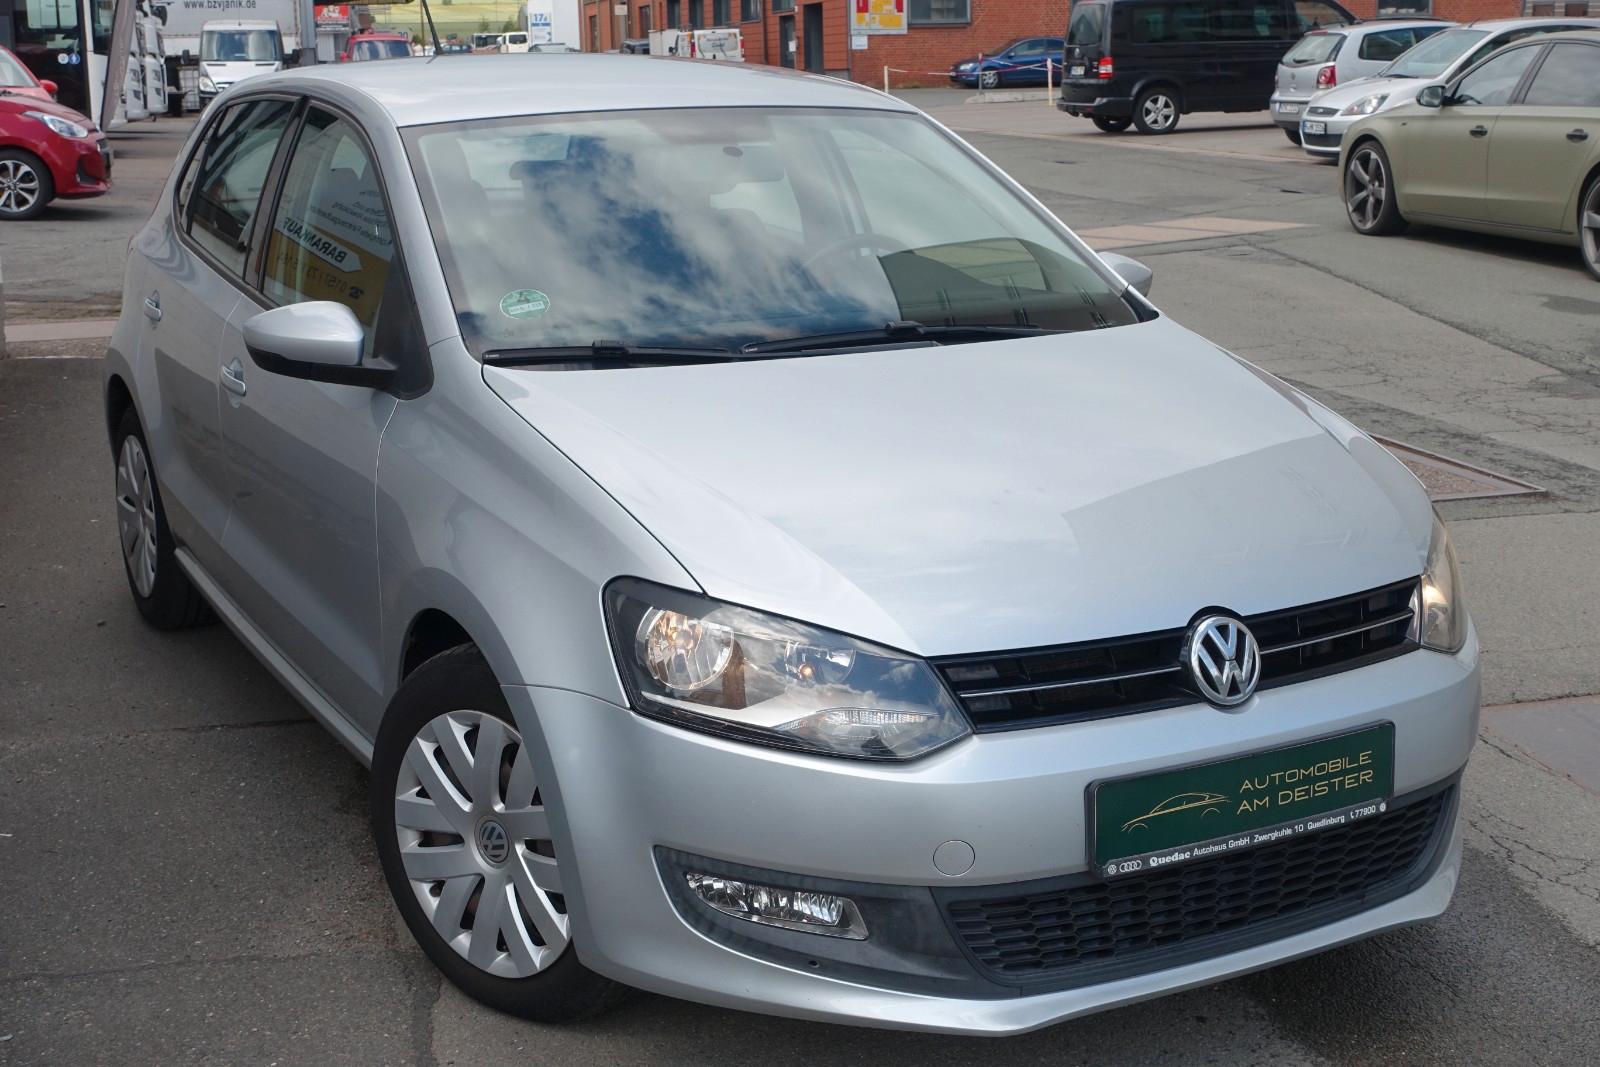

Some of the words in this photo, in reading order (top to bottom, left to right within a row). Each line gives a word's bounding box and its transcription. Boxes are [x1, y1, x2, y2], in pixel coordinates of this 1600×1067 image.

[1236, 796, 1269, 815] AM
[1278, 769, 1374, 806] DEISTER
[1239, 750, 1373, 794] AUTOMOBILE
[1149, 850, 1191, 867] Quedac
[1193, 843, 1227, 857] Autohaus
[1228, 836, 1250, 849] GmbH
[1254, 828, 1293, 844] Zwergkuhle
[1294, 823, 1304, 833] 10
[1307, 815, 1345, 831] Quedlinburg
[1355, 805, 1376, 818] 77900
